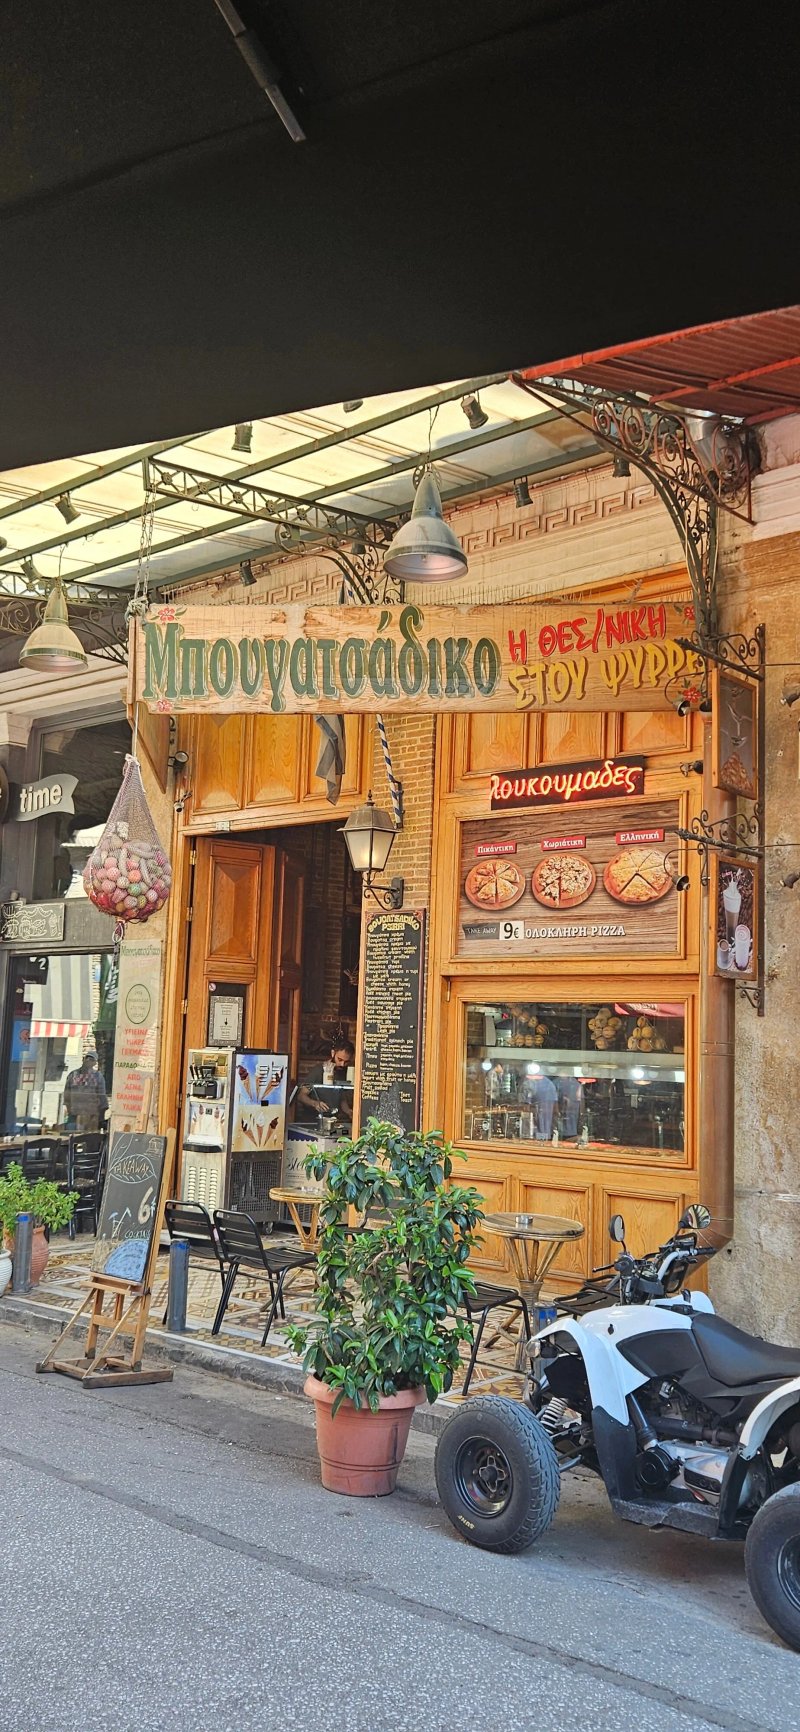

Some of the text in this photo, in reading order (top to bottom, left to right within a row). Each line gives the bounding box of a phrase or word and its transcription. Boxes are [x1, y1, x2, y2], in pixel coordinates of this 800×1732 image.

[508, 604, 666, 664] Η ΘΕΣ/ΝΙΚΗ
[142, 606, 502, 712] Μπουγατσάδικο
[508, 656, 589, 709] ΣΤΟΥ
[489, 760, 643, 800] λουκουμαδες
[20, 784, 62, 813] time
[477, 843, 514, 855] Πικάντικη
[543, 838, 584, 849] Χωριάτικη
[619, 831, 660, 843] Ελληνική
[525, 925, 626, 938] ΟΛΟΚΛΗΡΗ PIZZA
